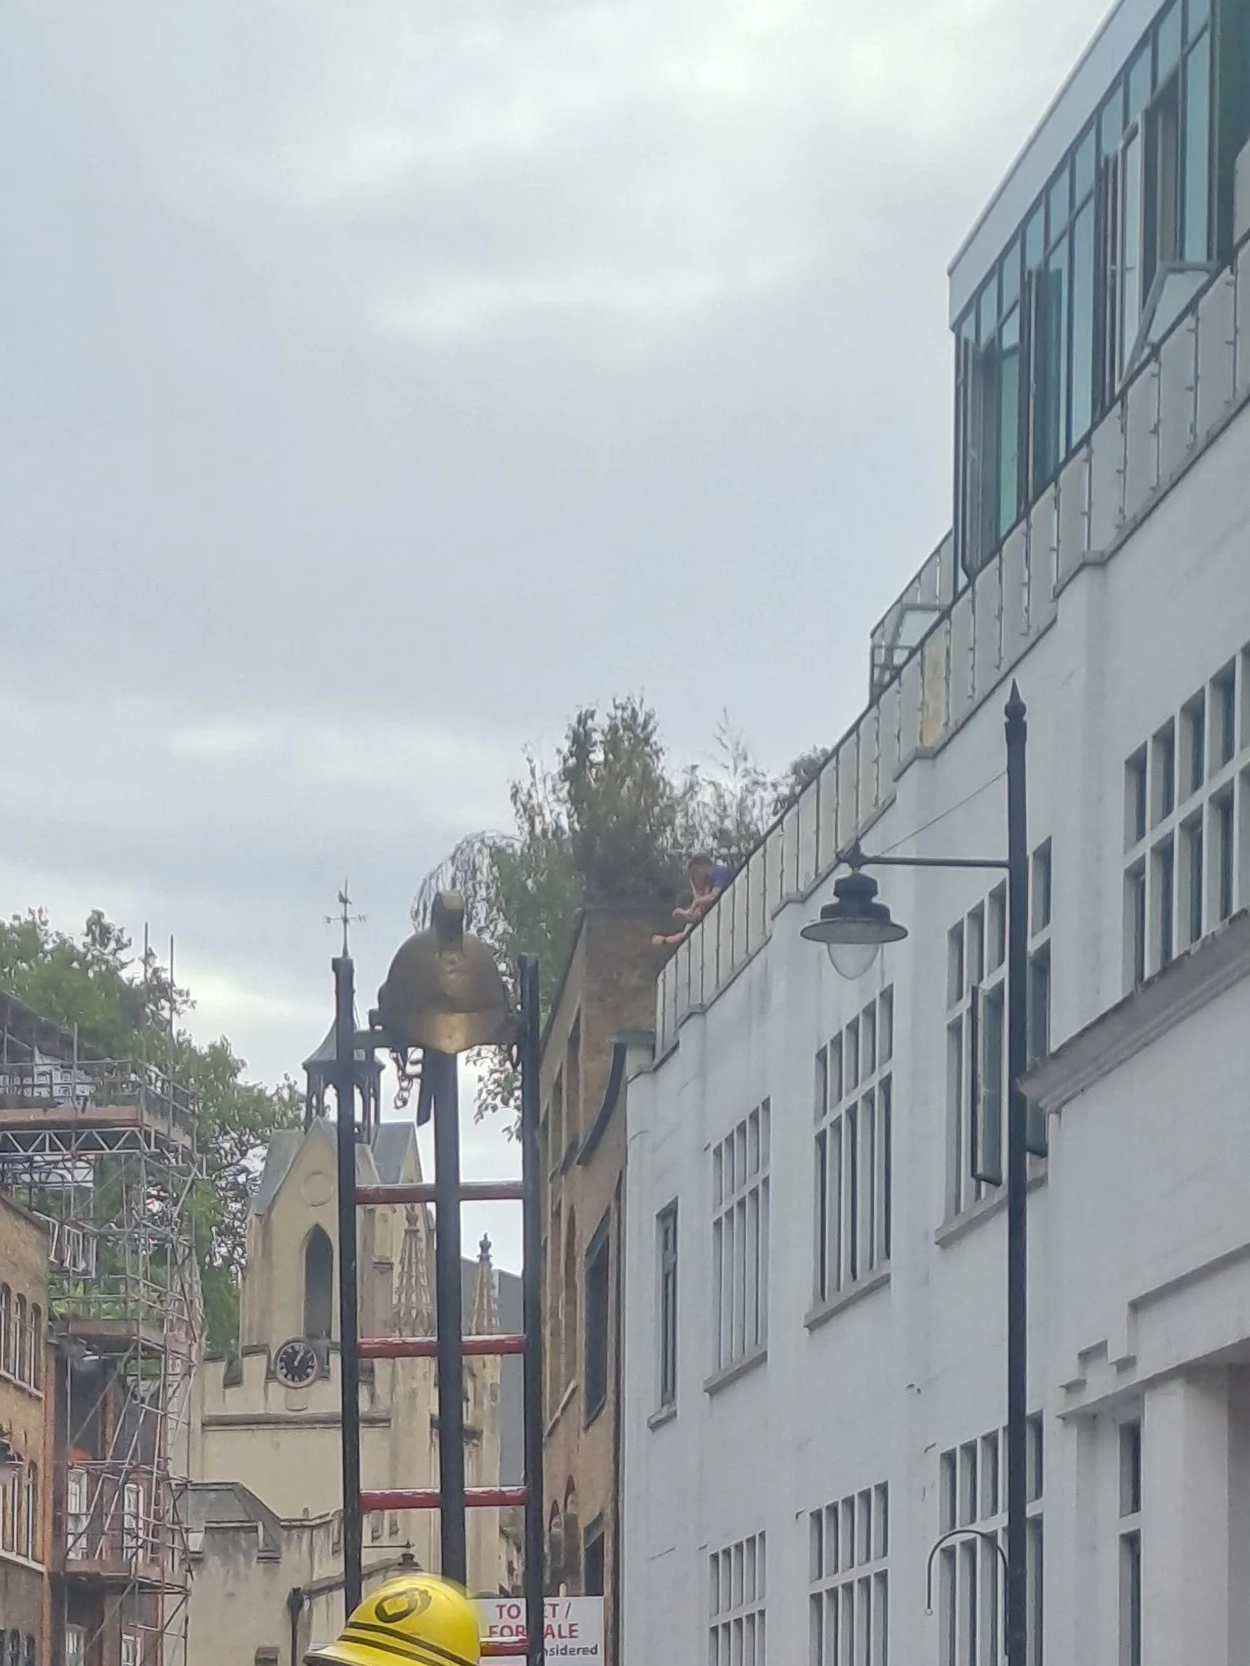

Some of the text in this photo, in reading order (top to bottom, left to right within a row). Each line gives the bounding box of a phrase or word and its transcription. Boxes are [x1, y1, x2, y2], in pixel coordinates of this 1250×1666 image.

[496, 1604, 521, 1619] TO
[489, 1623, 579, 1639] FOR ALE
[543, 1644, 598, 1656] nsidered
